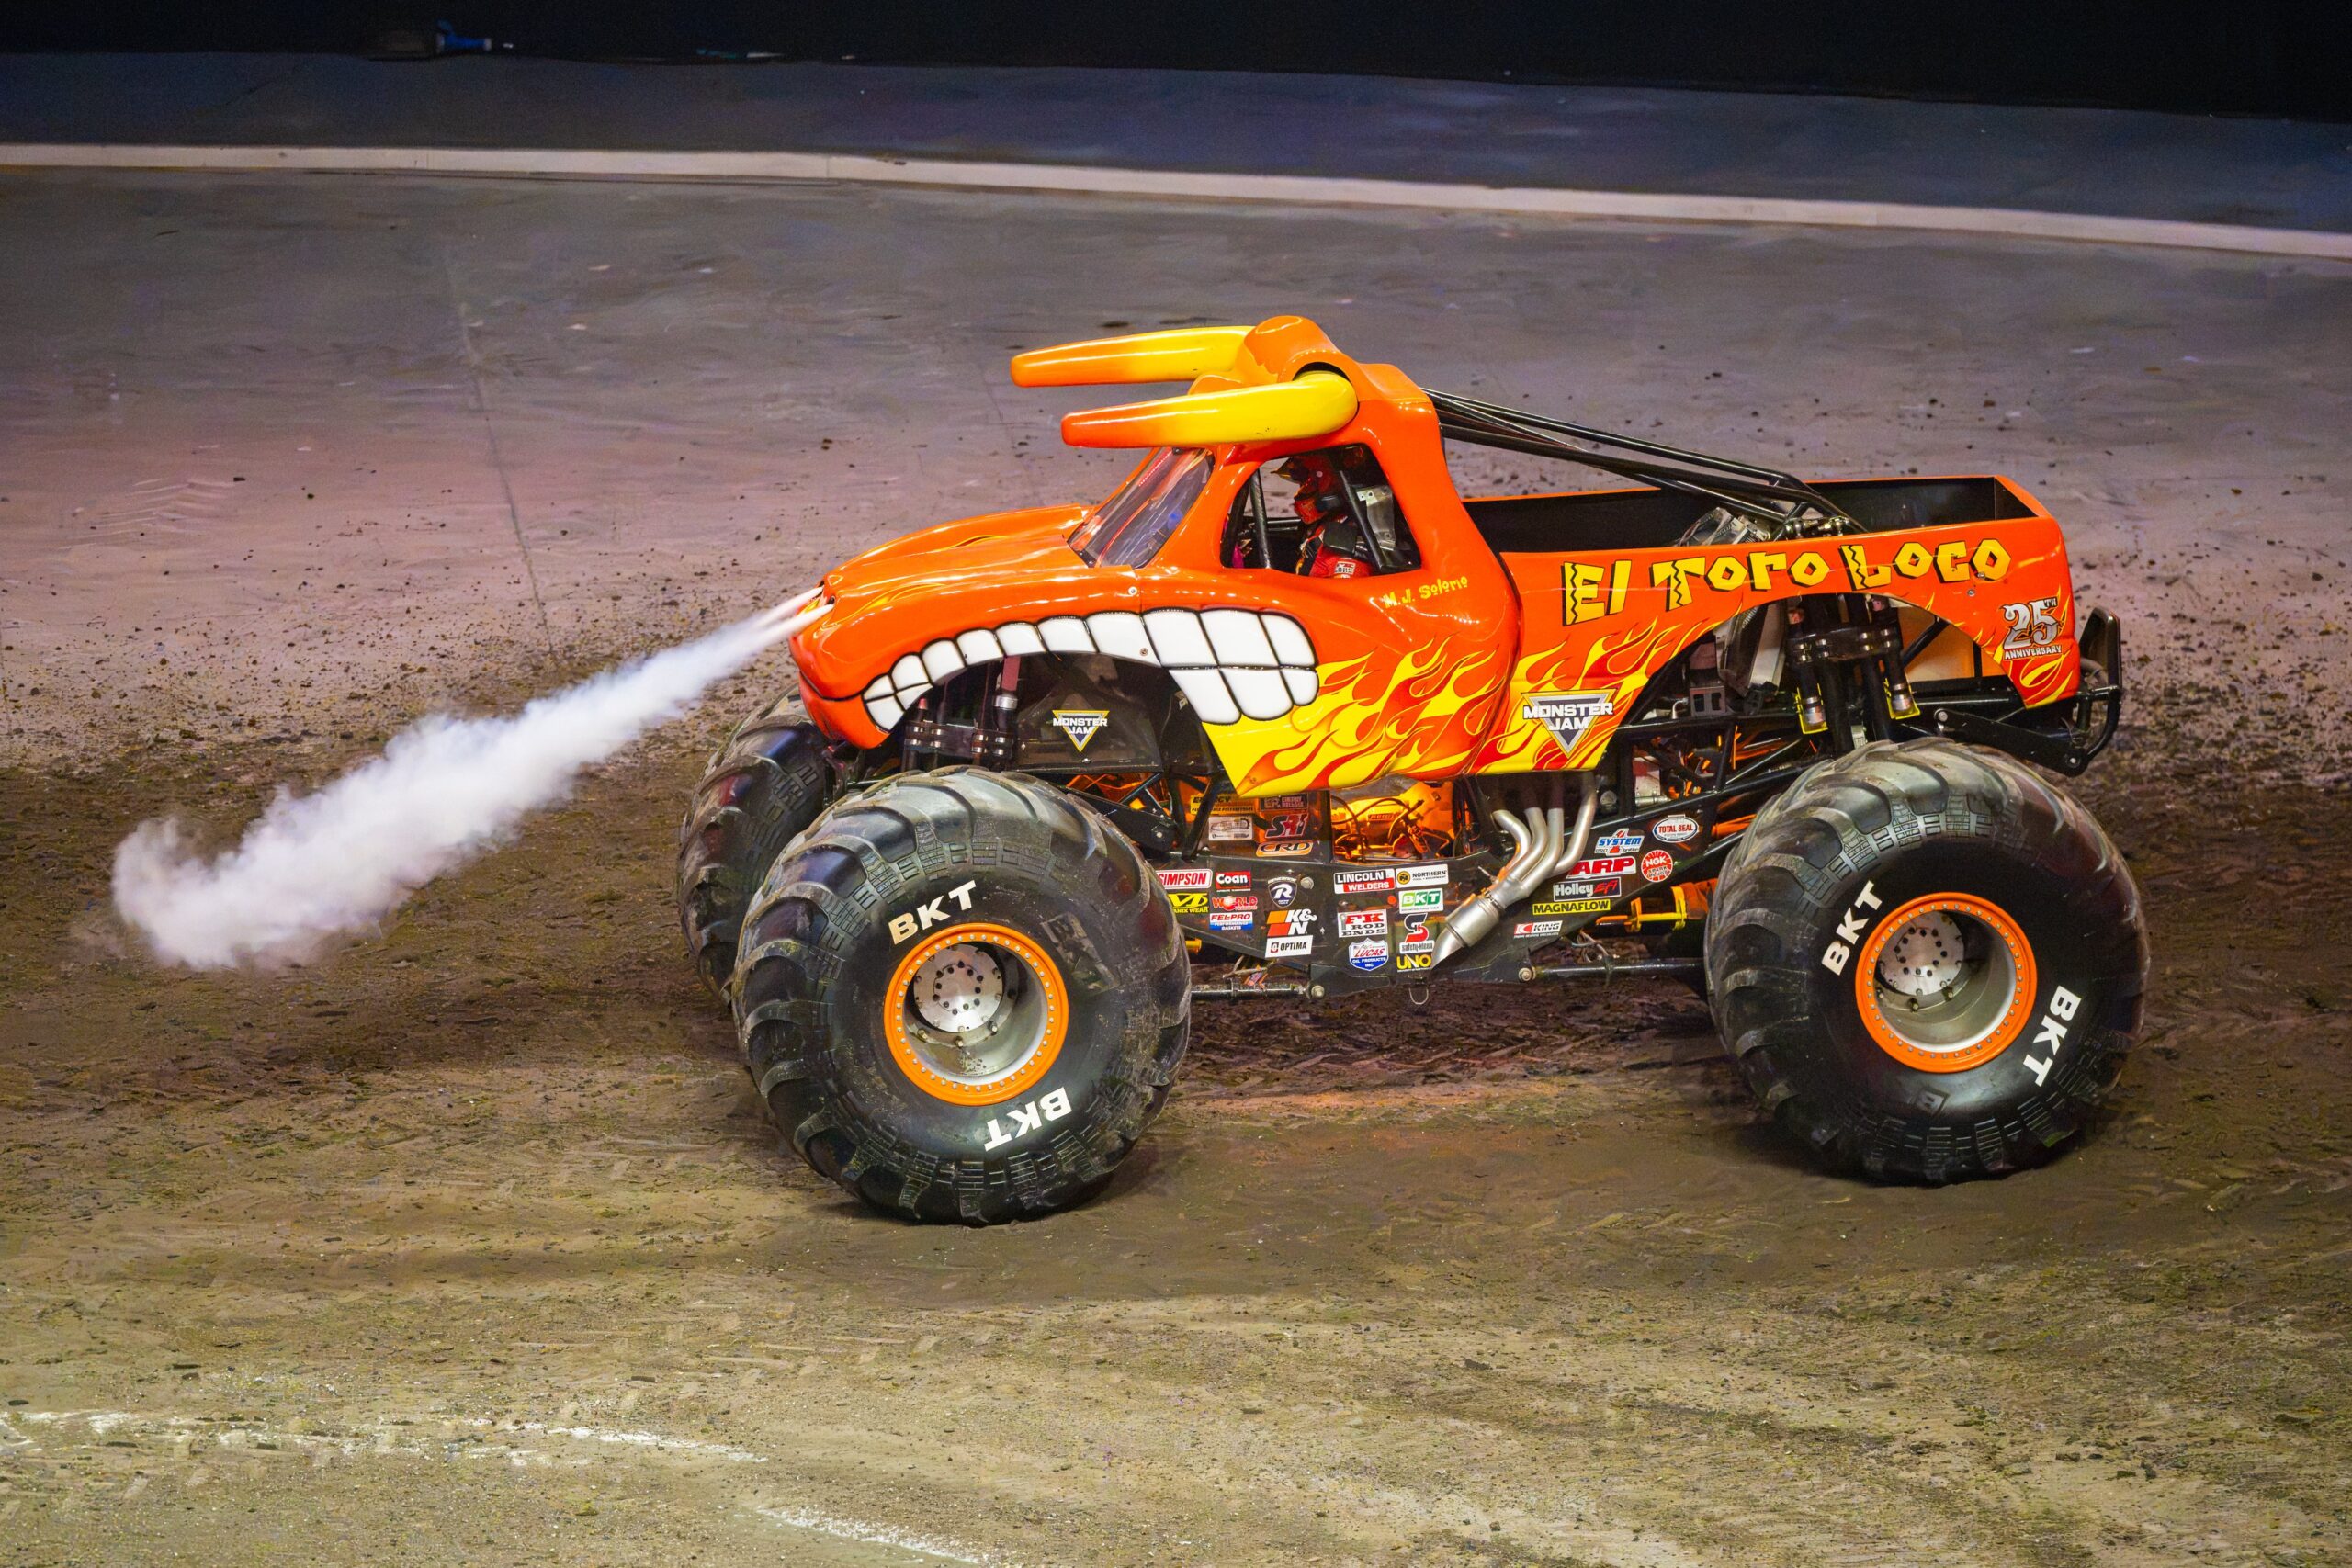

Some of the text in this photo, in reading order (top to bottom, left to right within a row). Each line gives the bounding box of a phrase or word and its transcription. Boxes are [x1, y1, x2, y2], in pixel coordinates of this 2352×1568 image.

[1563, 538, 2011, 626] El Toro Loco
[2004, 645, 2063, 660] ANNIVERSARY
[1522, 703, 1614, 719] MONSTER
[1052, 717, 1108, 727] MONSTER
[1548, 716, 1589, 731] JAM
[1069, 726, 1094, 735] JAM
[1658, 824, 1693, 833] TOTAL SEAL
[1598, 837, 1642, 846] SYSTEM
[1567, 857, 1635, 875] ARP
[1645, 856, 1667, 867] NGK
[1159, 872, 1207, 886] SIMPSON
[1216, 873, 1249, 885] Coan
[1337, 871, 1385, 883] LINCOLN
[1412, 870, 1447, 878] NORTHERN
[1348, 882, 1390, 891] WELDERS
[1555, 883, 1594, 897] Holley
[1402, 891, 1441, 907] BKT
[888, 880, 977, 945] BKT
[1533, 900, 1609, 914] MAGNAFLOW
[1211, 913, 1251, 921] FEL-PRO
[1345, 912, 1385, 924] FK
[1533, 922, 1560, 931] KING
[1821, 879, 1883, 976] BKT
[1280, 942, 1307, 952] OPTIMA
[1354, 947, 1385, 958] LUCAS
[2022, 985, 2082, 1087] BKT
[984, 1087, 1072, 1152] BKT
